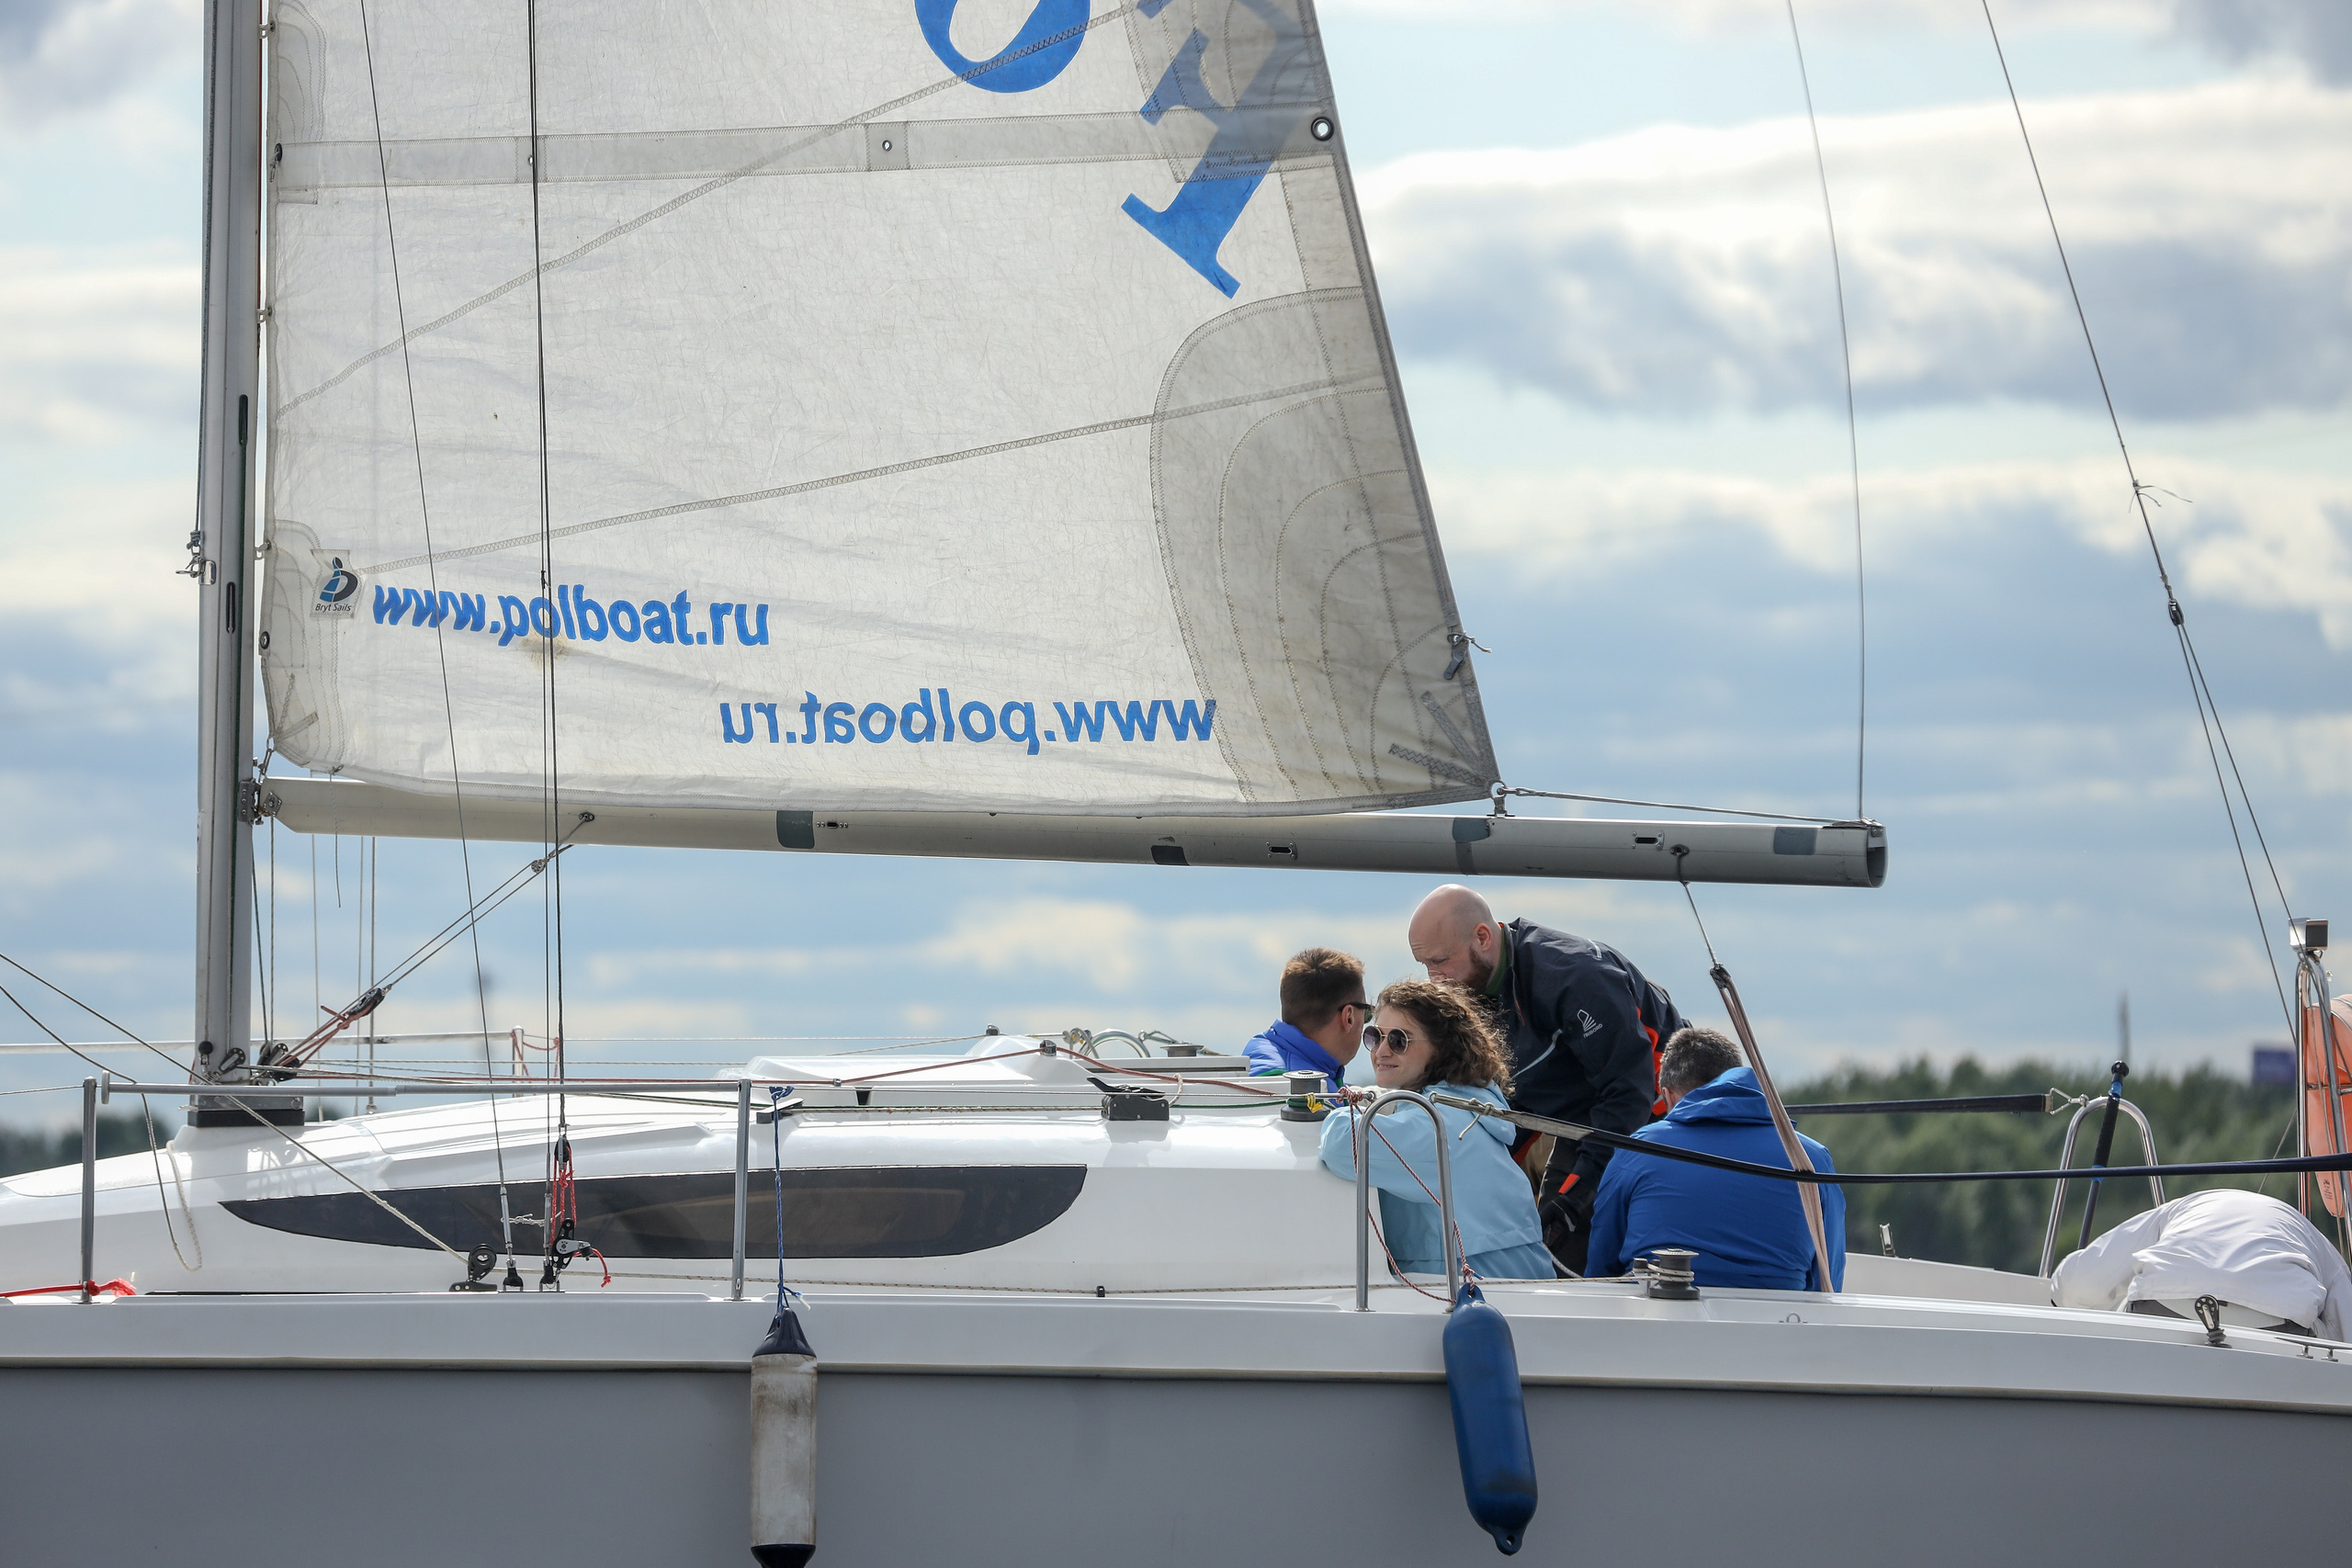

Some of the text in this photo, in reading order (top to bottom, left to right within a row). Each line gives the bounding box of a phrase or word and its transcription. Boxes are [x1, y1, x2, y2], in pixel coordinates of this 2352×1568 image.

[315, 603, 352, 613] Bryt Sails
[373, 584, 769, 647] www.polboat.ru
